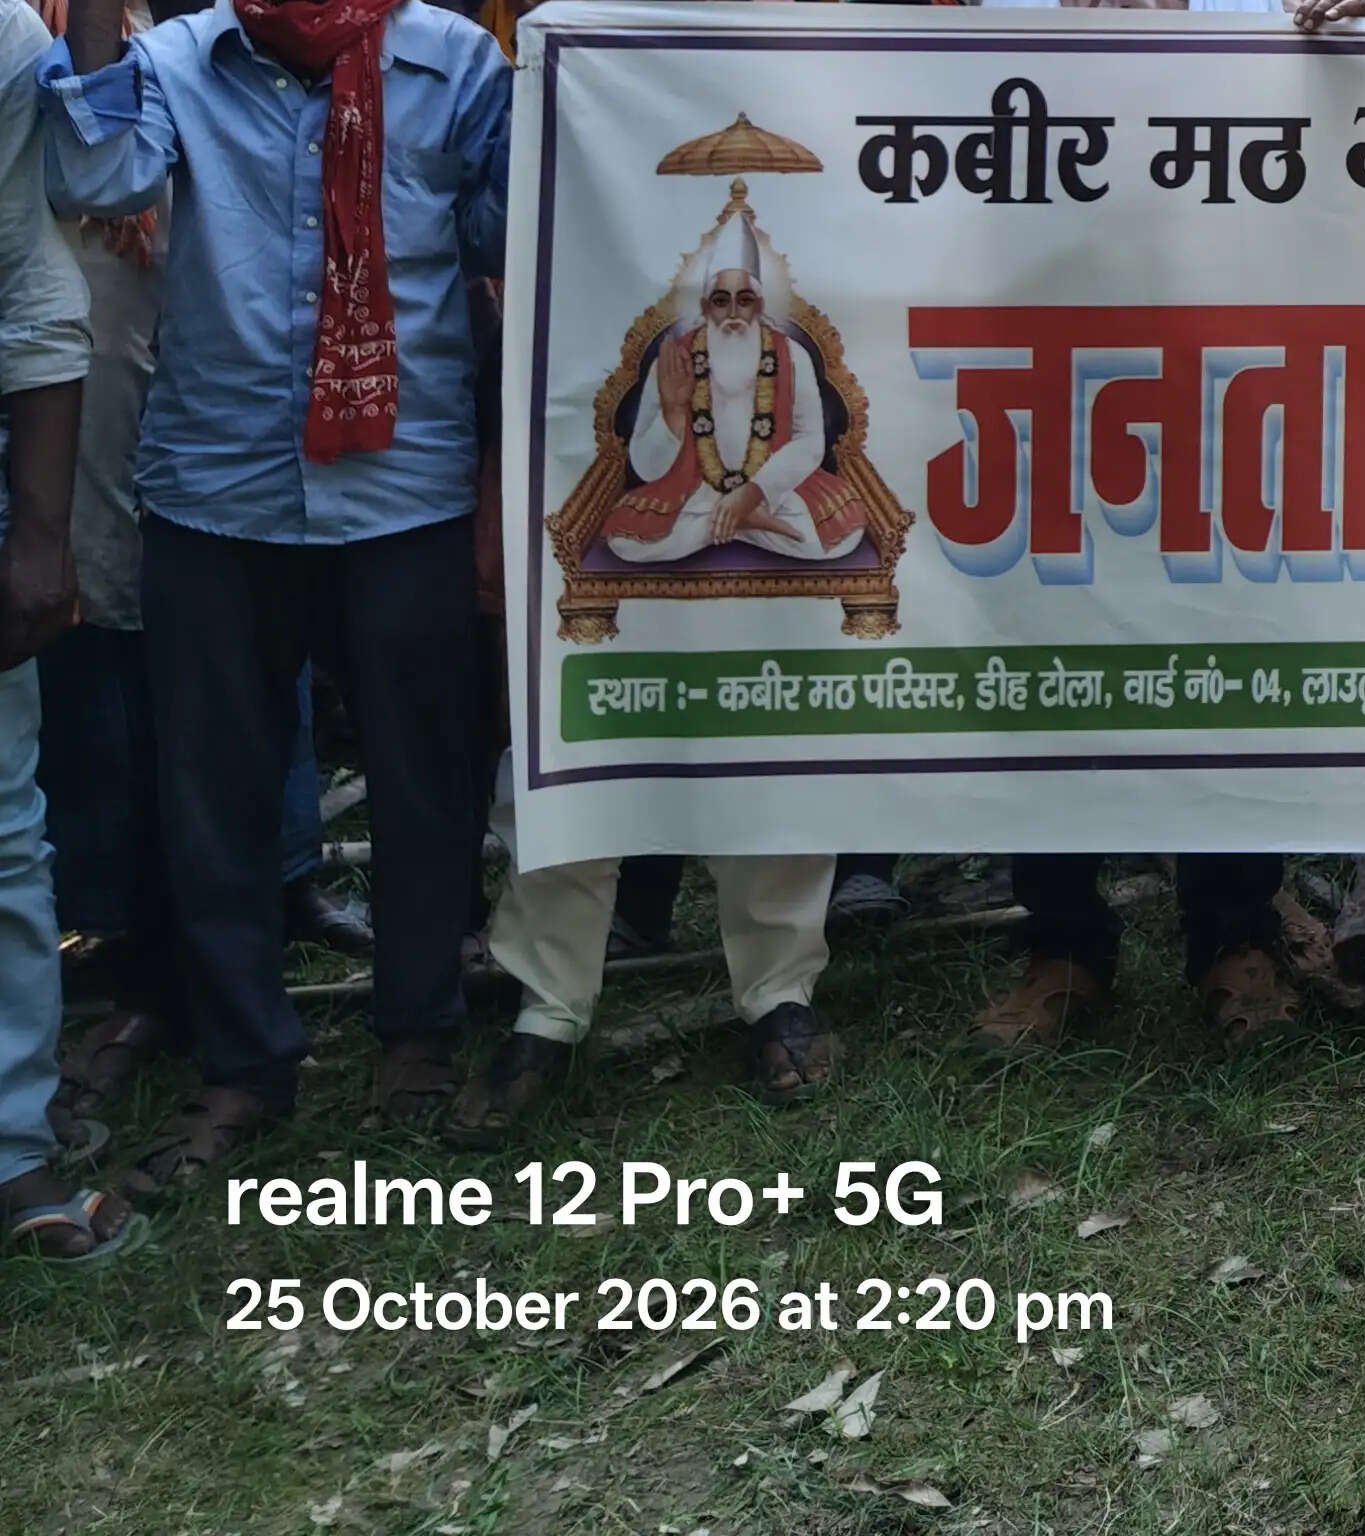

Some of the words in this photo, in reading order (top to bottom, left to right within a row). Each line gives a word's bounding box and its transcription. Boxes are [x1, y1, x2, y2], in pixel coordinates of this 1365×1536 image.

[855, 76, 1115, 205] कबीर
[1148, 117, 1310, 205] मठ
[587, 677, 668, 715] स्थान
[717, 661, 802, 711] कबीर
[808, 675, 857, 710] मठ
[861, 658, 965, 713] परिसर,
[974, 656, 1030, 711] डीह
[1038, 657, 1114, 709] टोला,
[1123, 654, 1179, 709] वार्ड
